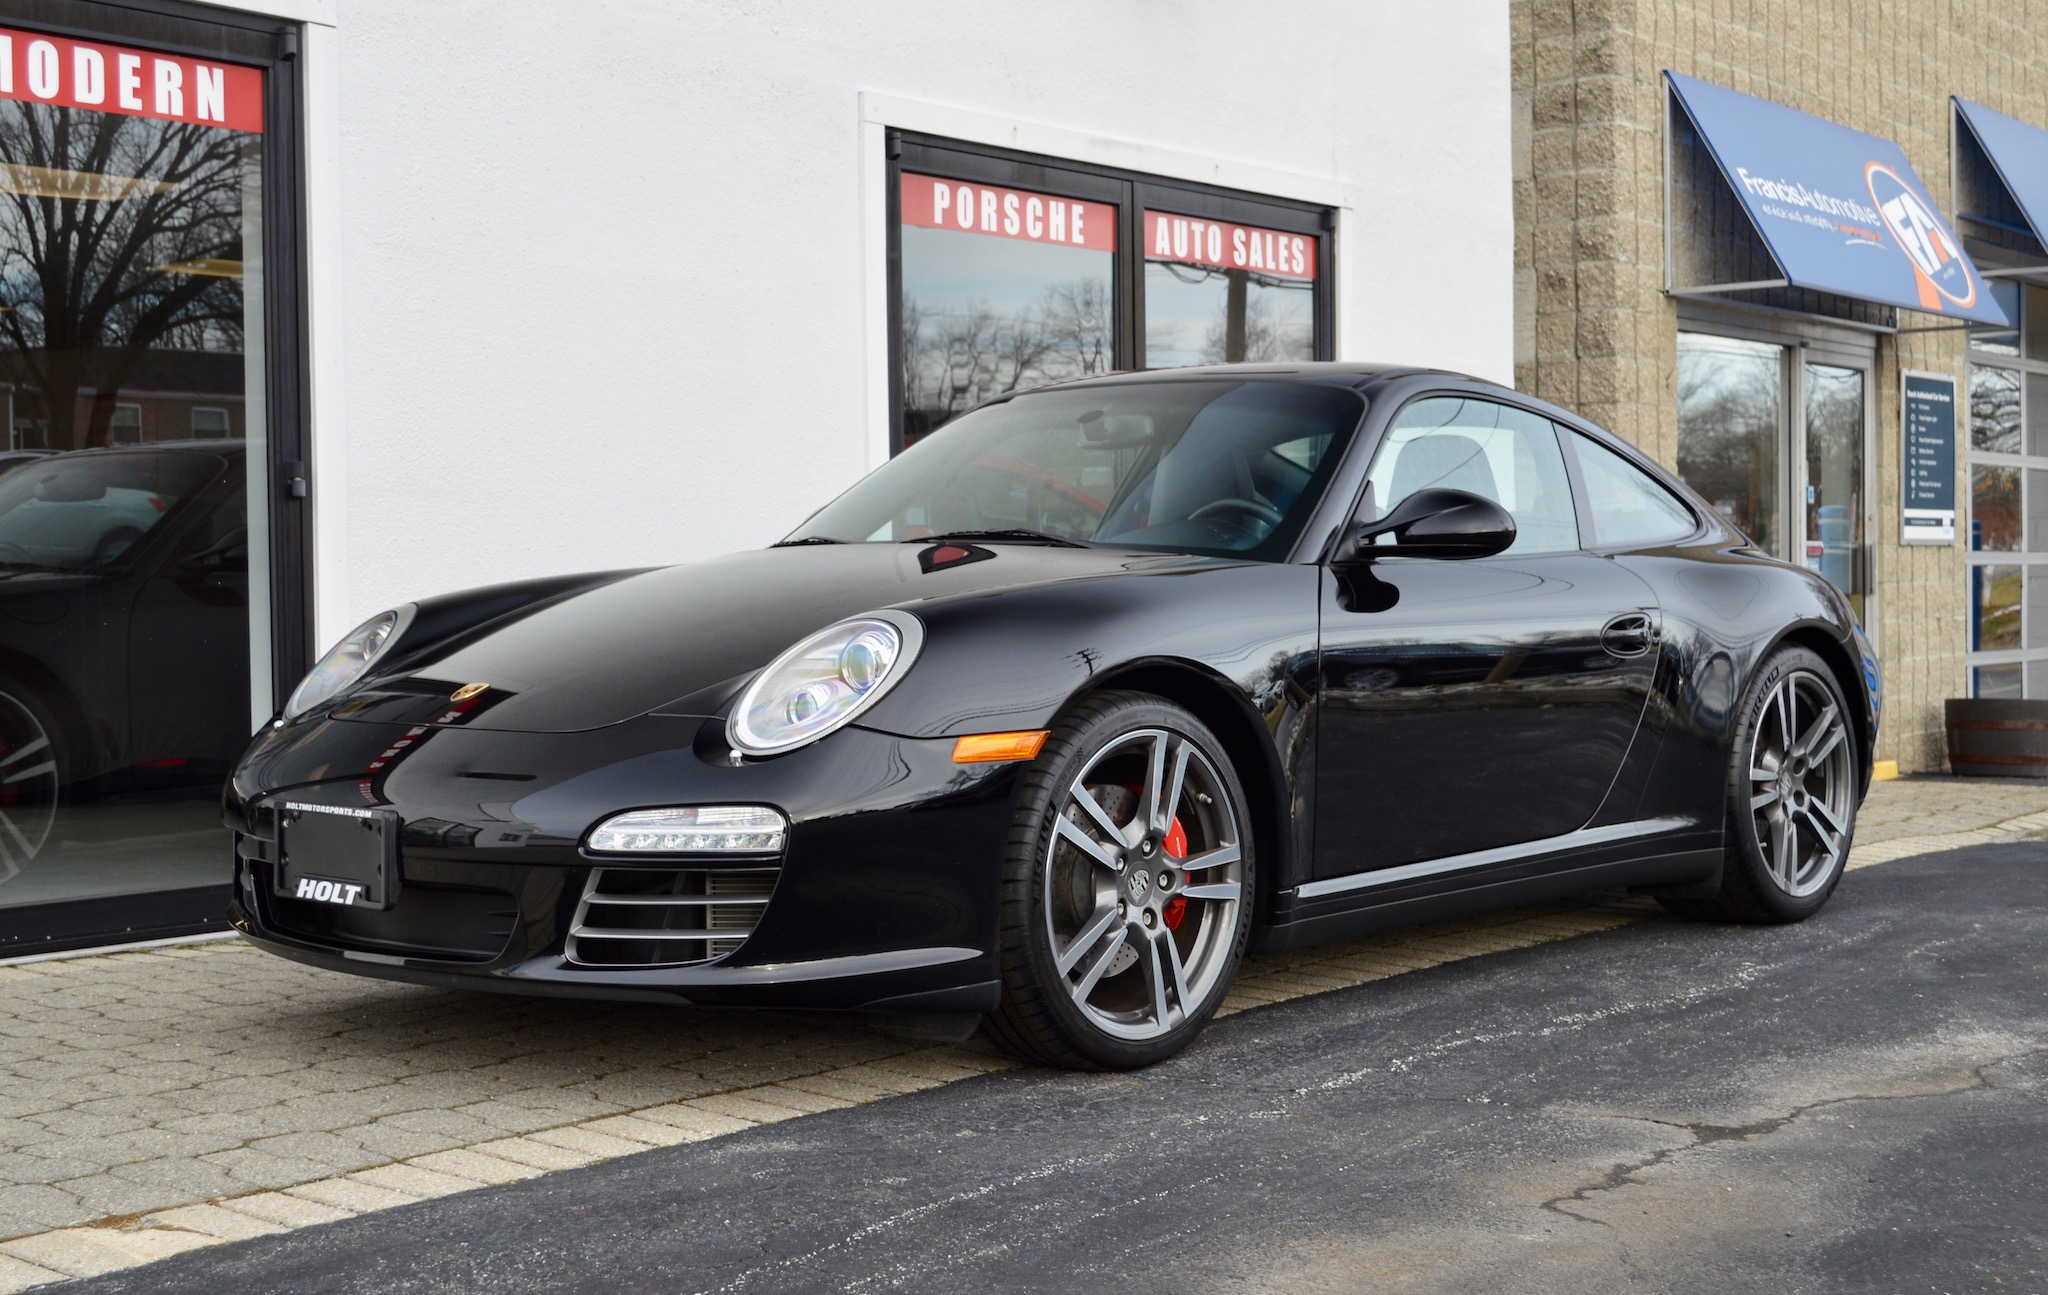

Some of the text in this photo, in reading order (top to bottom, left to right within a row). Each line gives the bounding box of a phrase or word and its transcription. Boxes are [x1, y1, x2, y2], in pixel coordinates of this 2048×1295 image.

[933, 182, 1085, 245] PORSCHE
[1155, 216, 1305, 275] AUTO SALES
[286, 802, 372, 818] HOLTMOTORSPORTS.COM
[296, 878, 361, 905] HOLT
